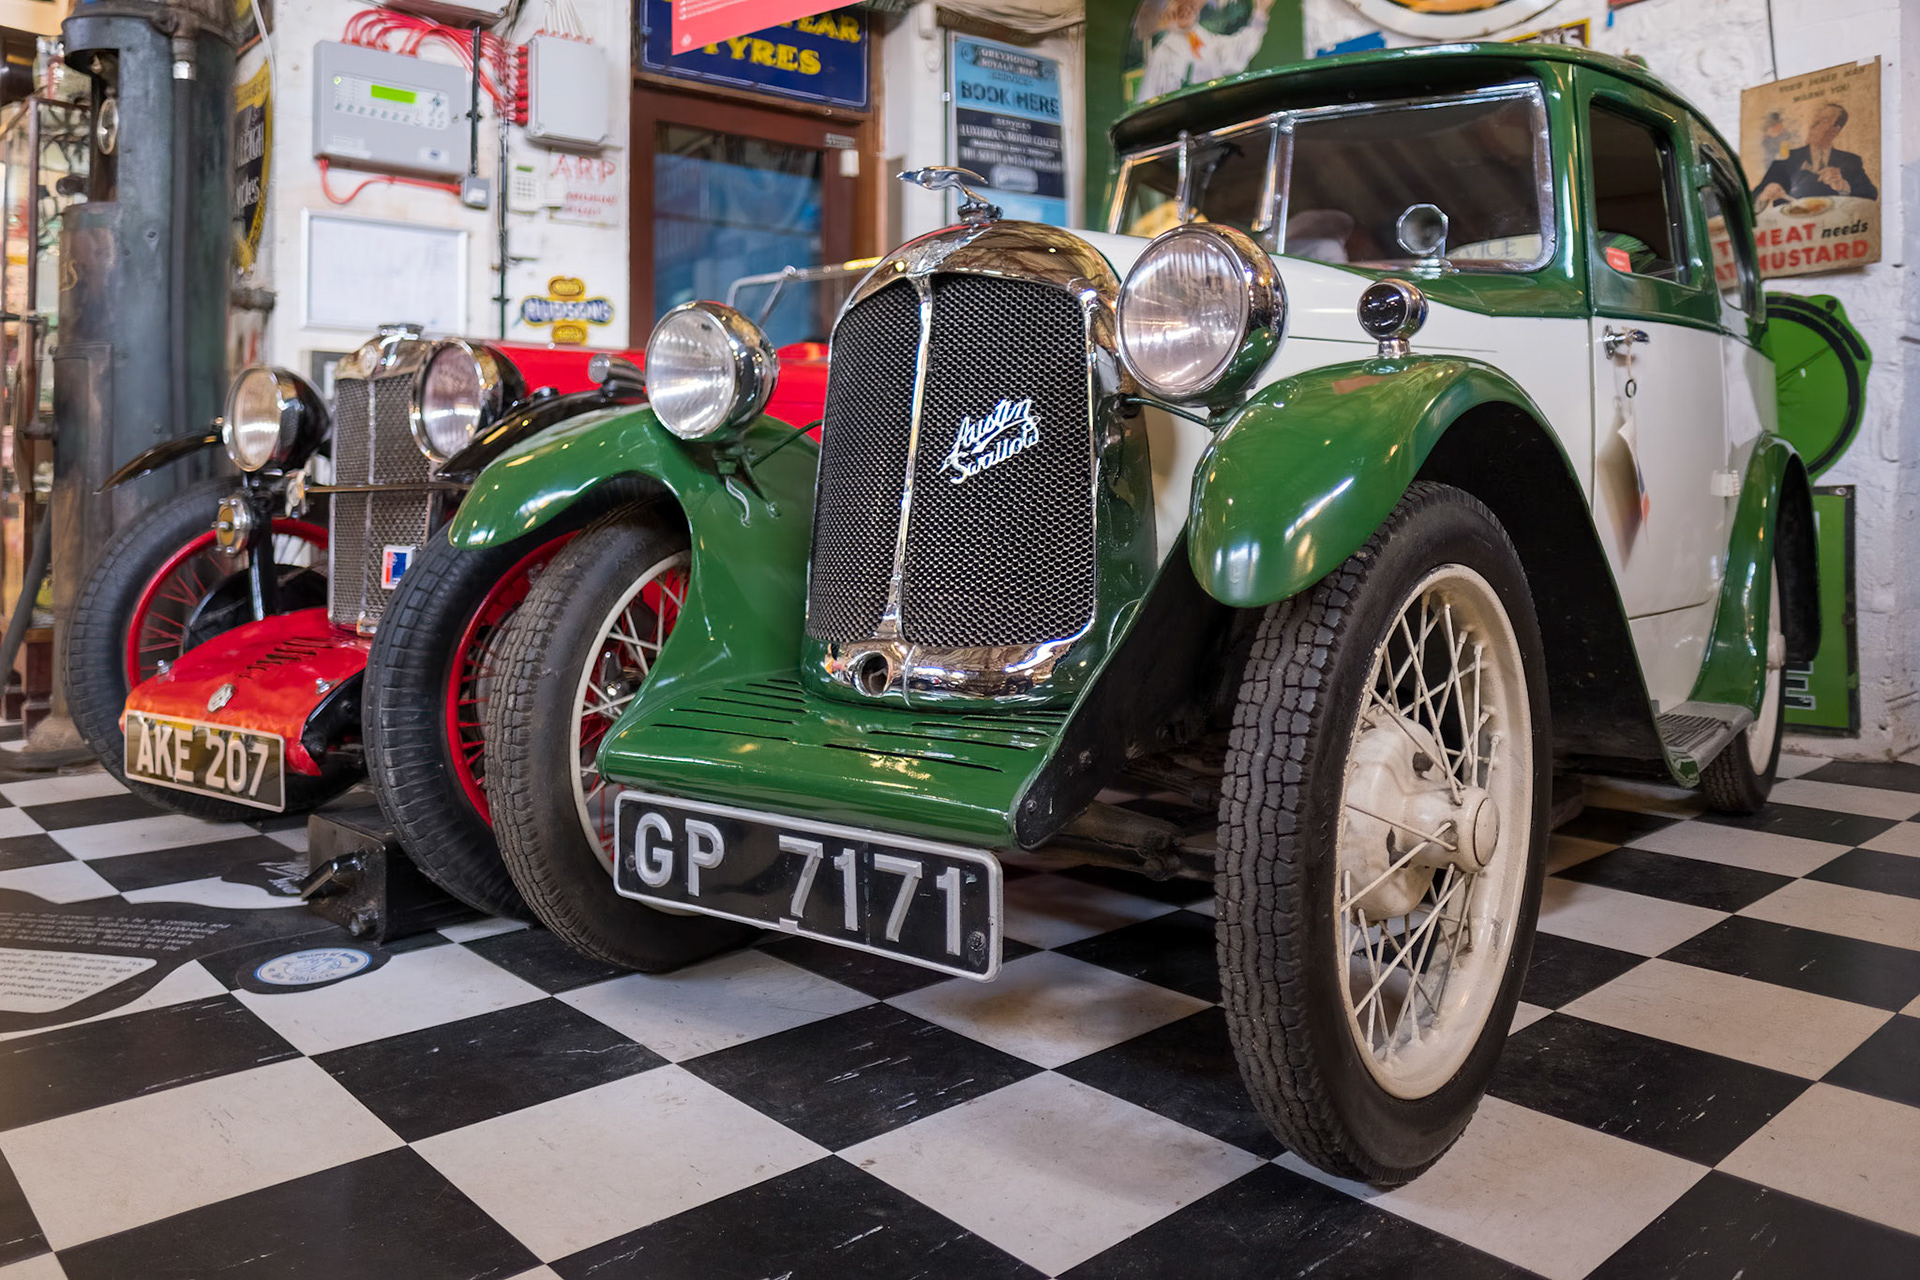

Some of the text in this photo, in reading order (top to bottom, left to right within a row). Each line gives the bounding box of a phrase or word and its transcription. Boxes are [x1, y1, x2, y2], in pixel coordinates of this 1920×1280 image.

[961, 80, 1060, 116] BOOK HERE
[1755, 219, 1868, 247] MEAT needs
[949, 420, 1039, 484] Swallow
[950, 397, 1033, 450] Austin
[136, 722, 269, 797] AKE 207
[634, 812, 961, 956] GP 7171
